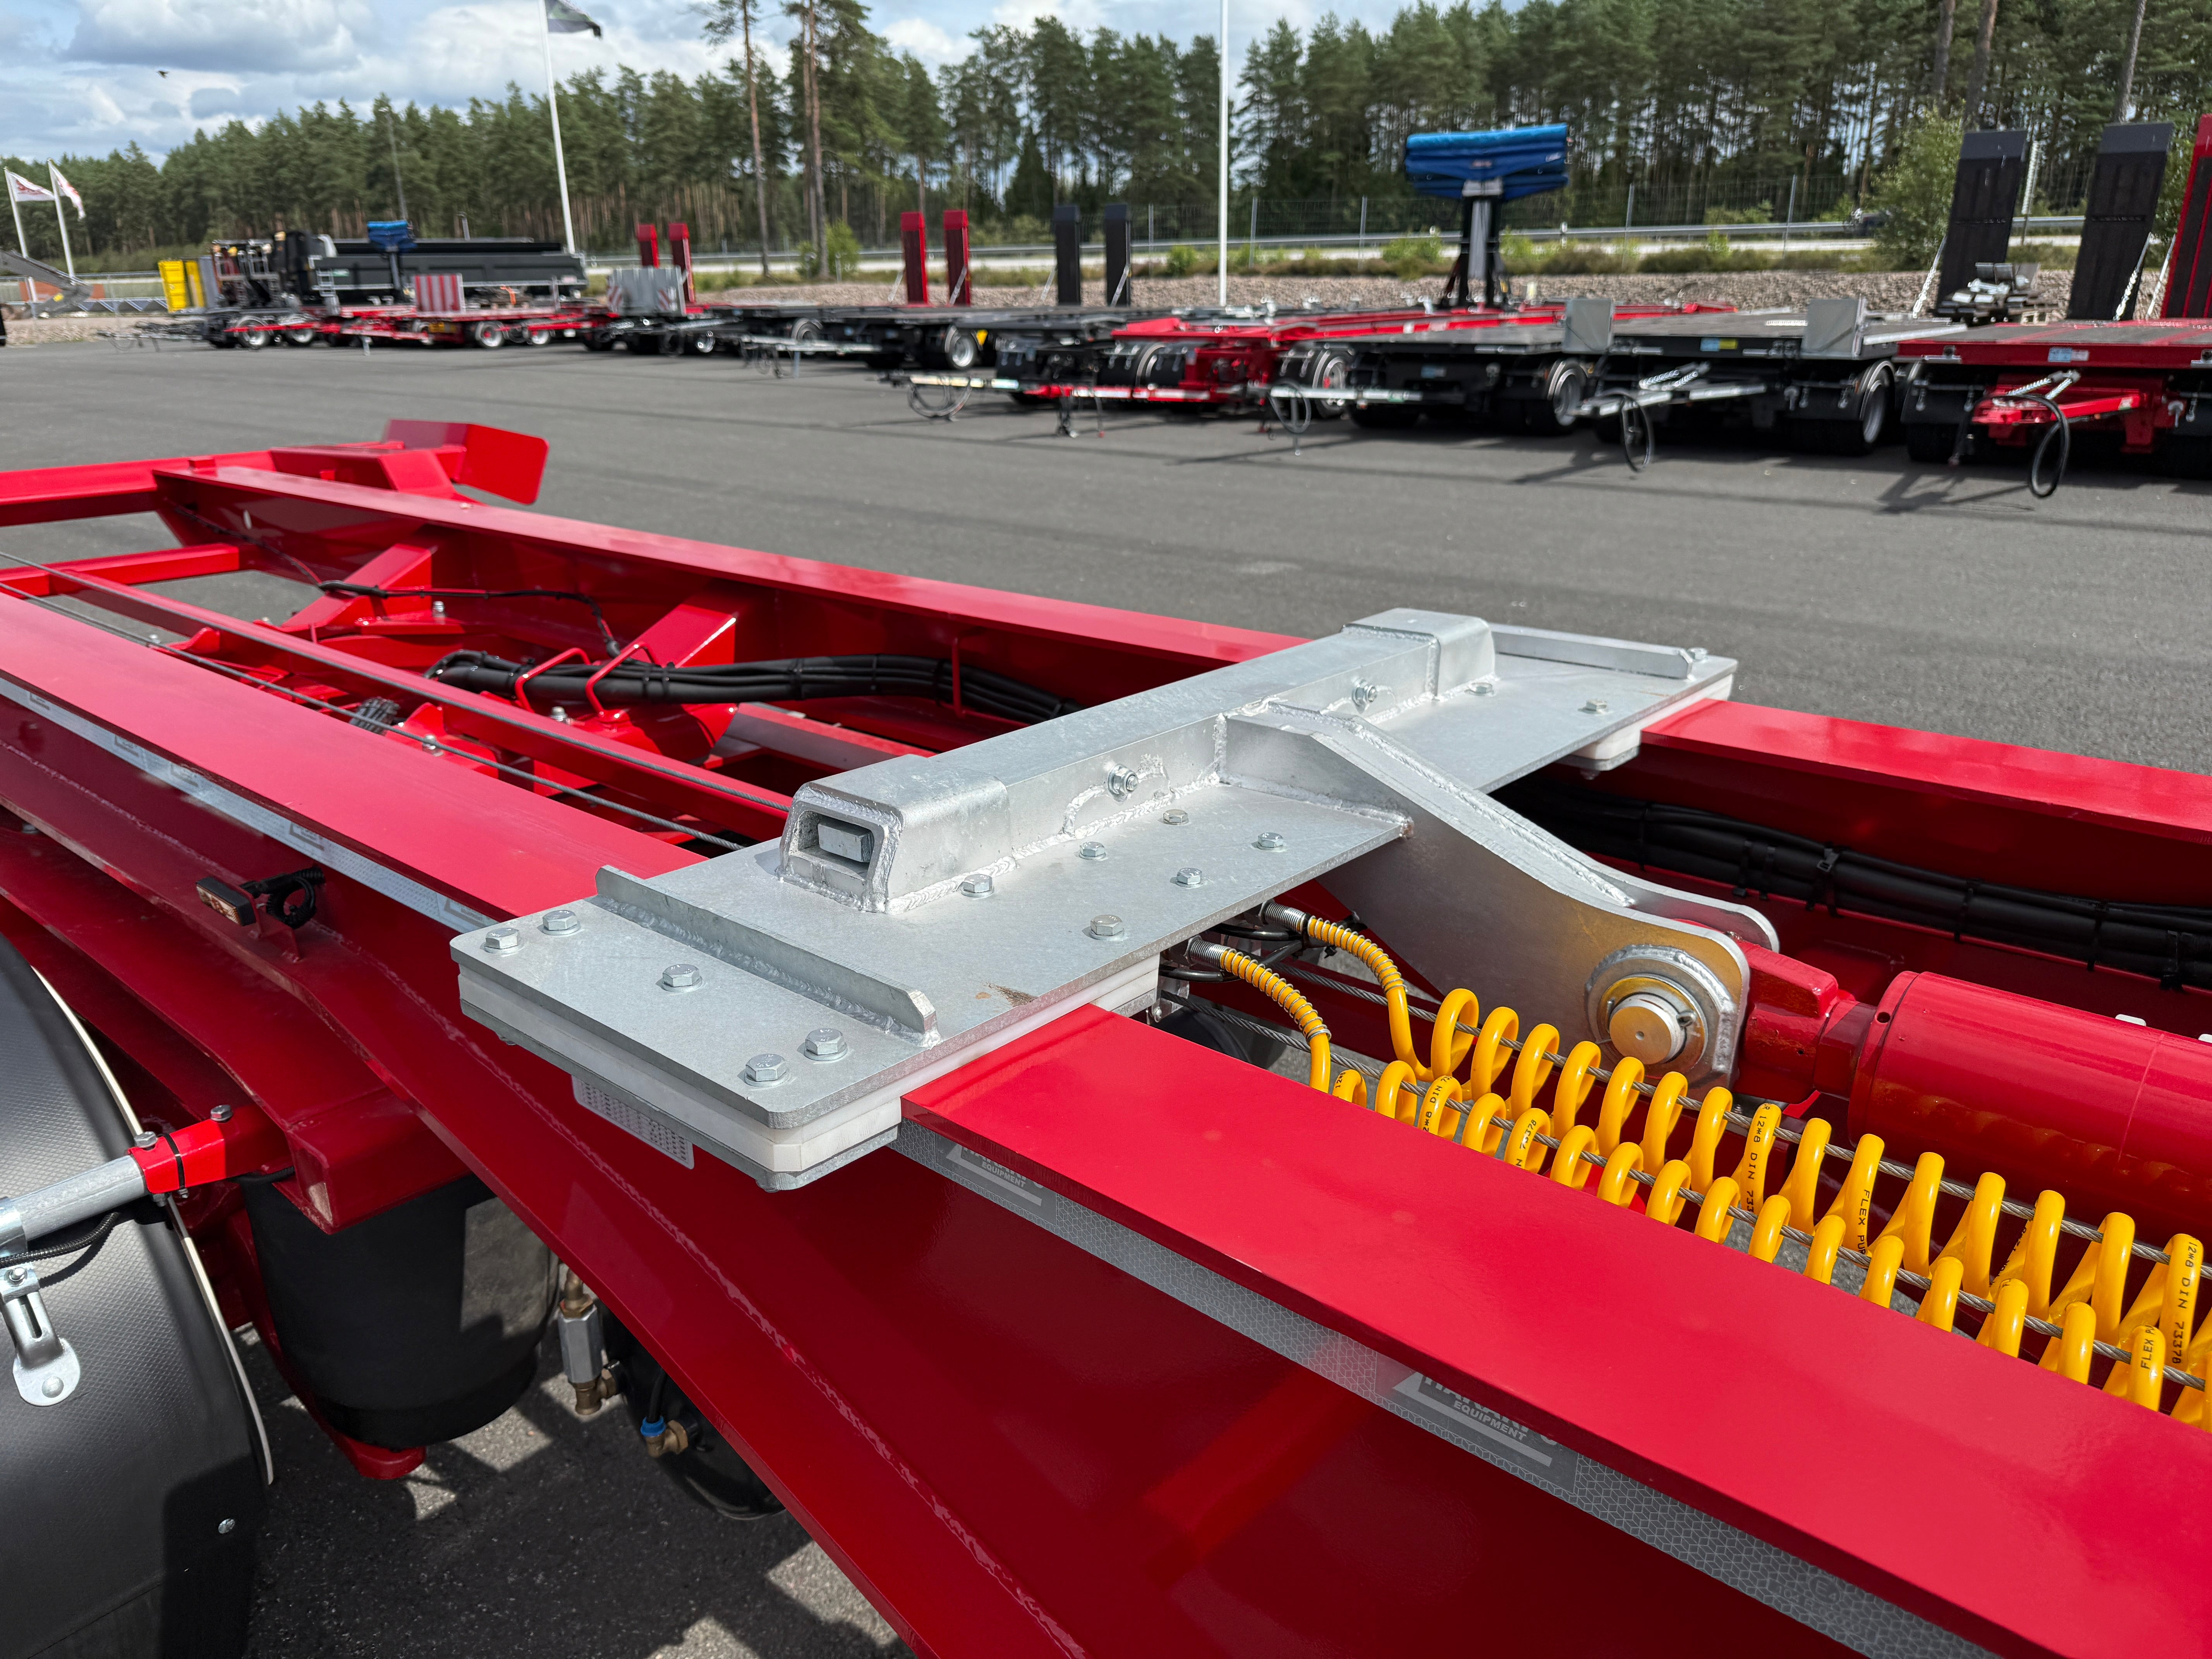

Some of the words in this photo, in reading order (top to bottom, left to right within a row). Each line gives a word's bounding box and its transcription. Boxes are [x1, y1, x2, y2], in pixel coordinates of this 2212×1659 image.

[1430, 1085, 1443, 1103] DIN
[982, 1162, 1026, 1187] EQUIPMENT
[1748, 1152, 1757, 1180] DIN
[1858, 1189, 1870, 1225] FLEX
[2177, 1277, 2190, 1309] DIN
[2141, 1339, 2154, 1369] FLEX
[2172, 1321, 2185, 1364] 73378
[1454, 1400, 1527, 1441] EQUIPMENT
